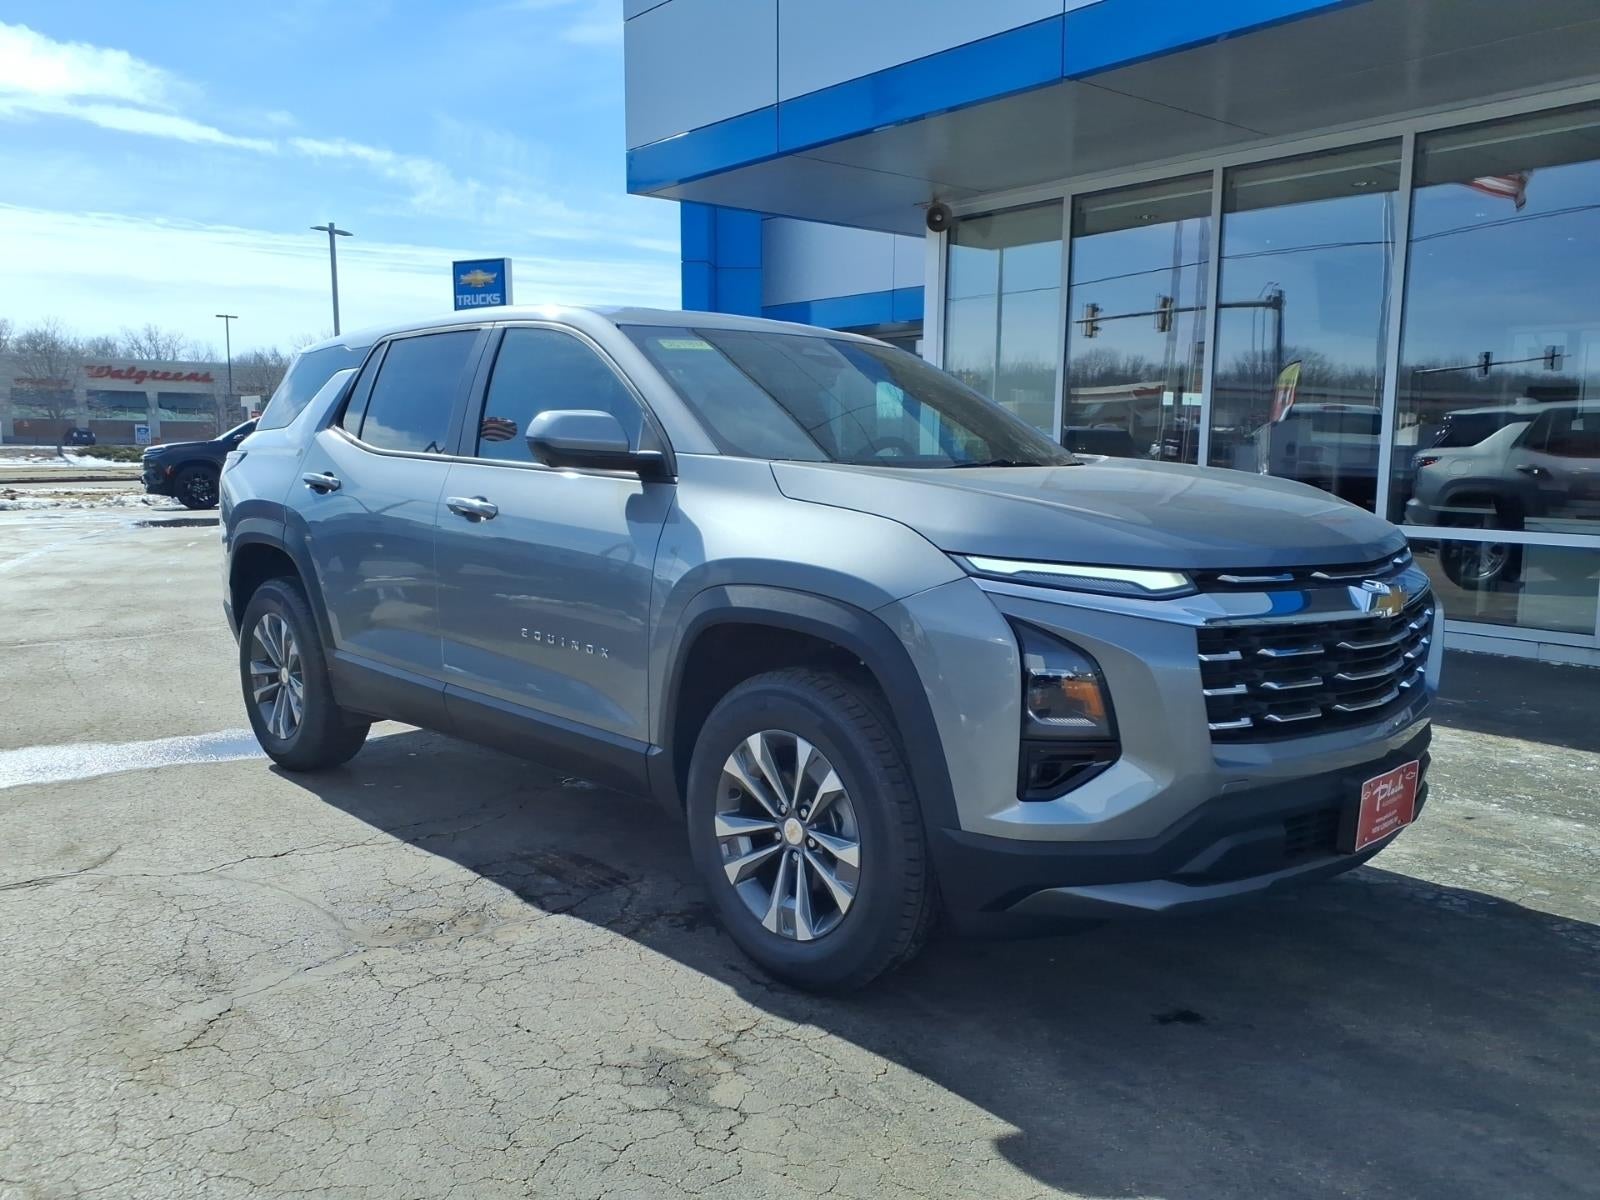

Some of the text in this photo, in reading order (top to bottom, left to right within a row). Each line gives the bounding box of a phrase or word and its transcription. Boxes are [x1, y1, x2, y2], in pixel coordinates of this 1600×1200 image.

[456, 293, 501, 306] TRUCKS
[85, 364, 214, 385] Walgreens
[521, 628, 609, 658] EQUINOX
